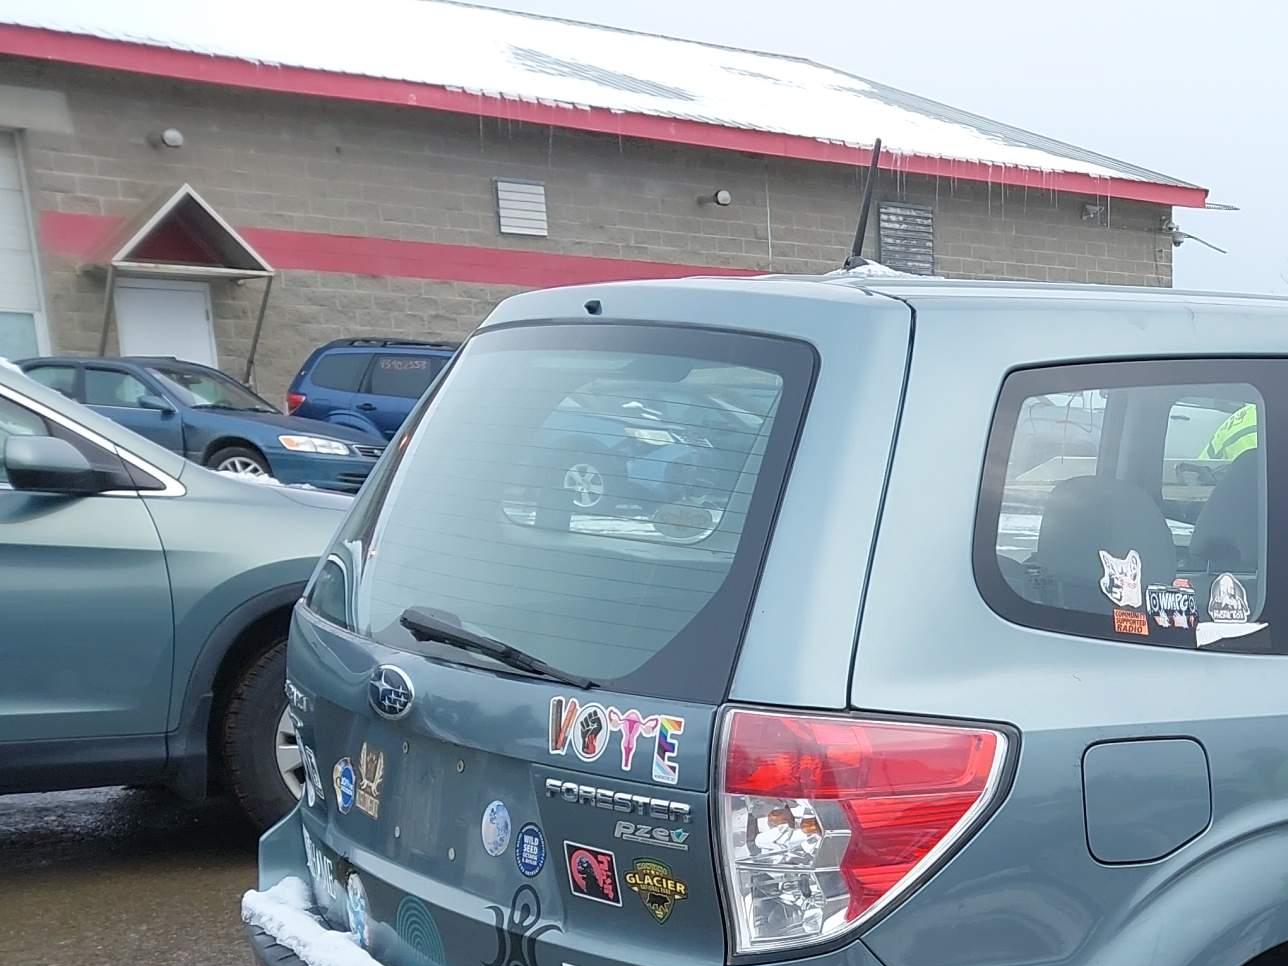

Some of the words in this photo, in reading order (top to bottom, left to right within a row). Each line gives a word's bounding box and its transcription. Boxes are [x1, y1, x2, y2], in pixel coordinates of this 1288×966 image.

[1159, 593, 1188, 611] WMPG
[1116, 618, 1147, 627] SUPPORTED
[1117, 625, 1143, 633] RADIO
[550, 697, 684, 784] VOTE
[545, 778, 692, 824] FORESTER
[523, 834, 539, 846] WILD
[523, 844, 538, 855] SEED
[625, 872, 686, 895] GLACIER
